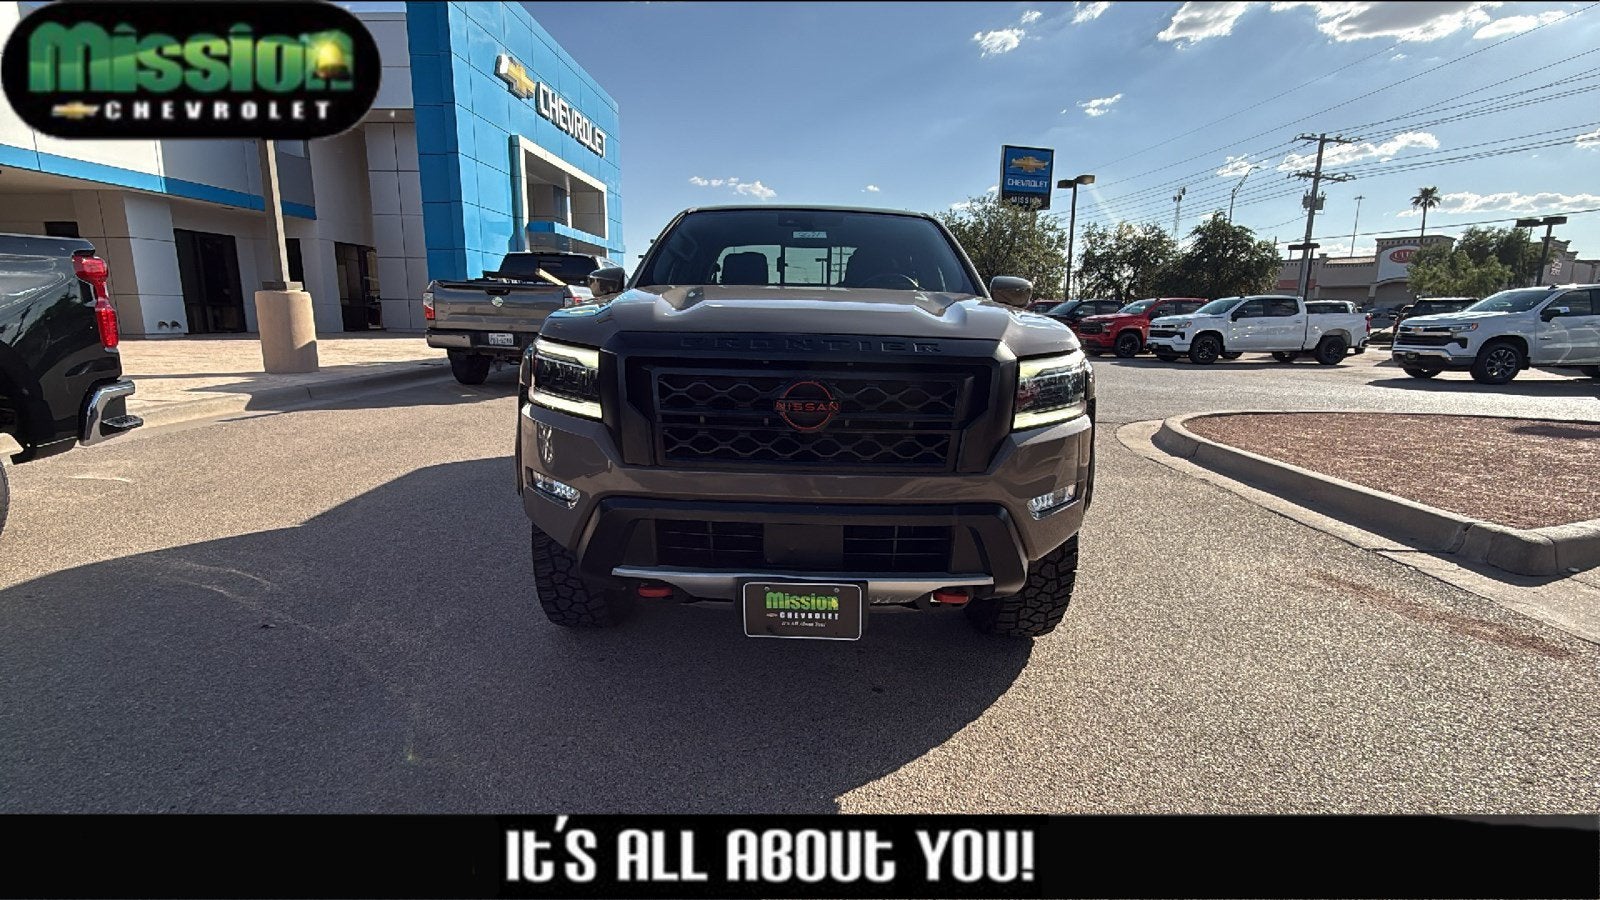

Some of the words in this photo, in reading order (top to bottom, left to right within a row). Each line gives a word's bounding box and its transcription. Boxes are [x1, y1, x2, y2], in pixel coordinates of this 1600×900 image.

[536, 82, 606, 158] CHEVROLET
[1007, 178, 1048, 188] CHEVROLET
[681, 337, 942, 353] FRONTIER
[775, 401, 840, 412] NISSAN
[766, 592, 839, 611] Mission
[780, 611, 838, 620] CHEVROLET
